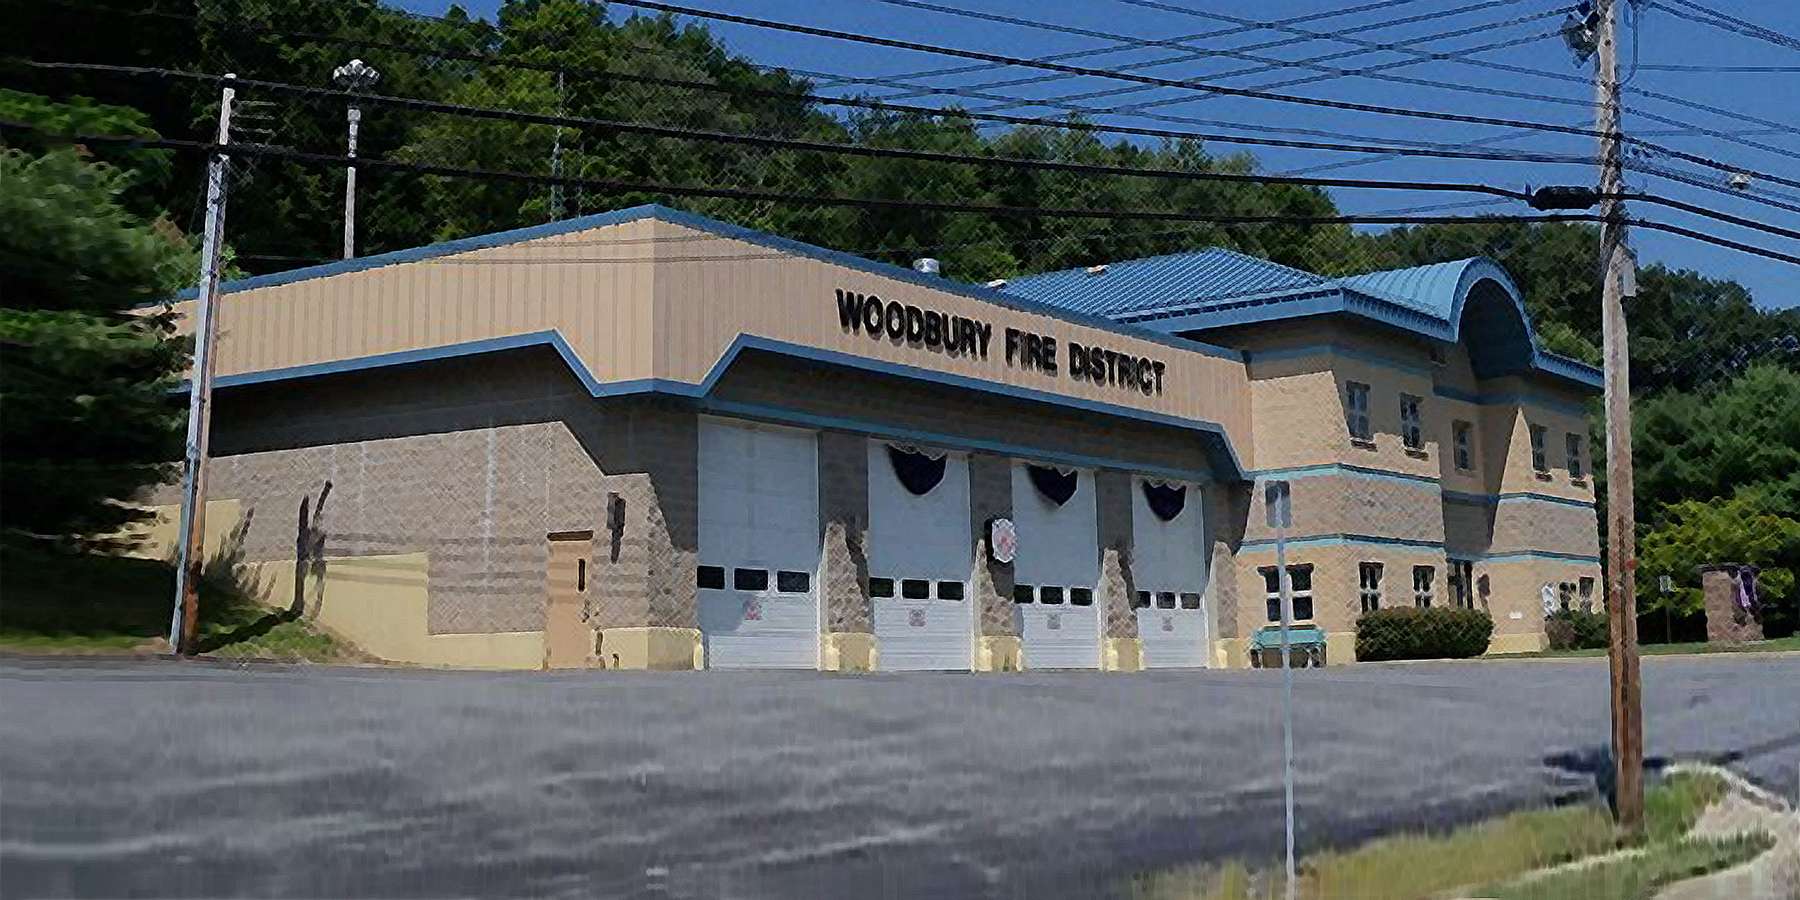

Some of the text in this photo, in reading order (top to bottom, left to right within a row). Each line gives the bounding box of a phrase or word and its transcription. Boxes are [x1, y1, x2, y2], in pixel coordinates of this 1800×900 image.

[835, 289, 1166, 396] WOODBURY FIRE DISTRICT
